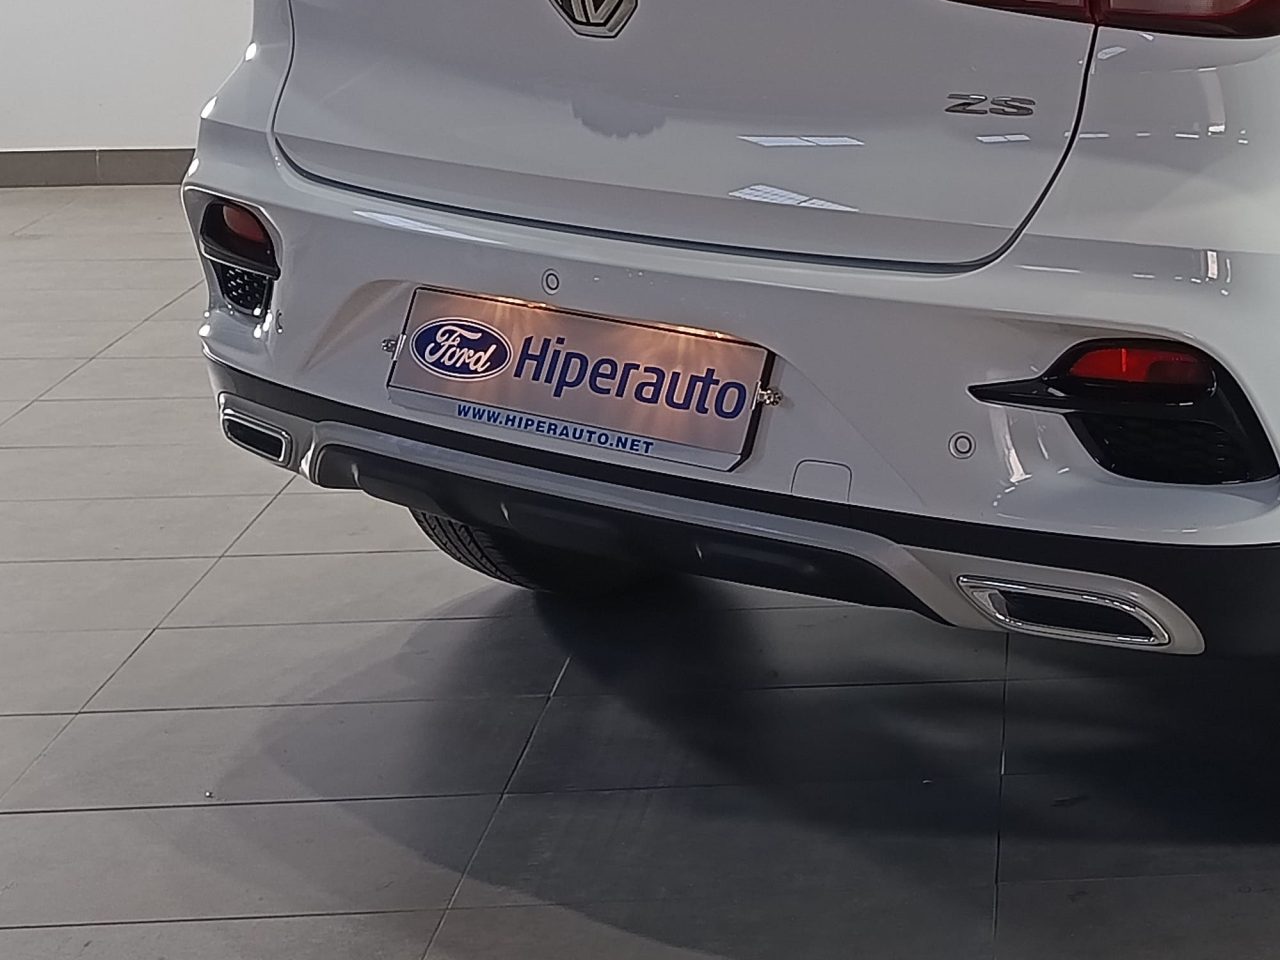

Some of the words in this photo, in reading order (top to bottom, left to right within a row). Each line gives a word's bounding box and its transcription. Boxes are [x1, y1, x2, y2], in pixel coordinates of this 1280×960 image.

[945, 94, 1036, 116] ZS
[425, 325, 497, 373] Ford
[512, 335, 748, 420] Hiperauto
[457, 404, 655, 455] WWW.HIPERAUTO.NET
